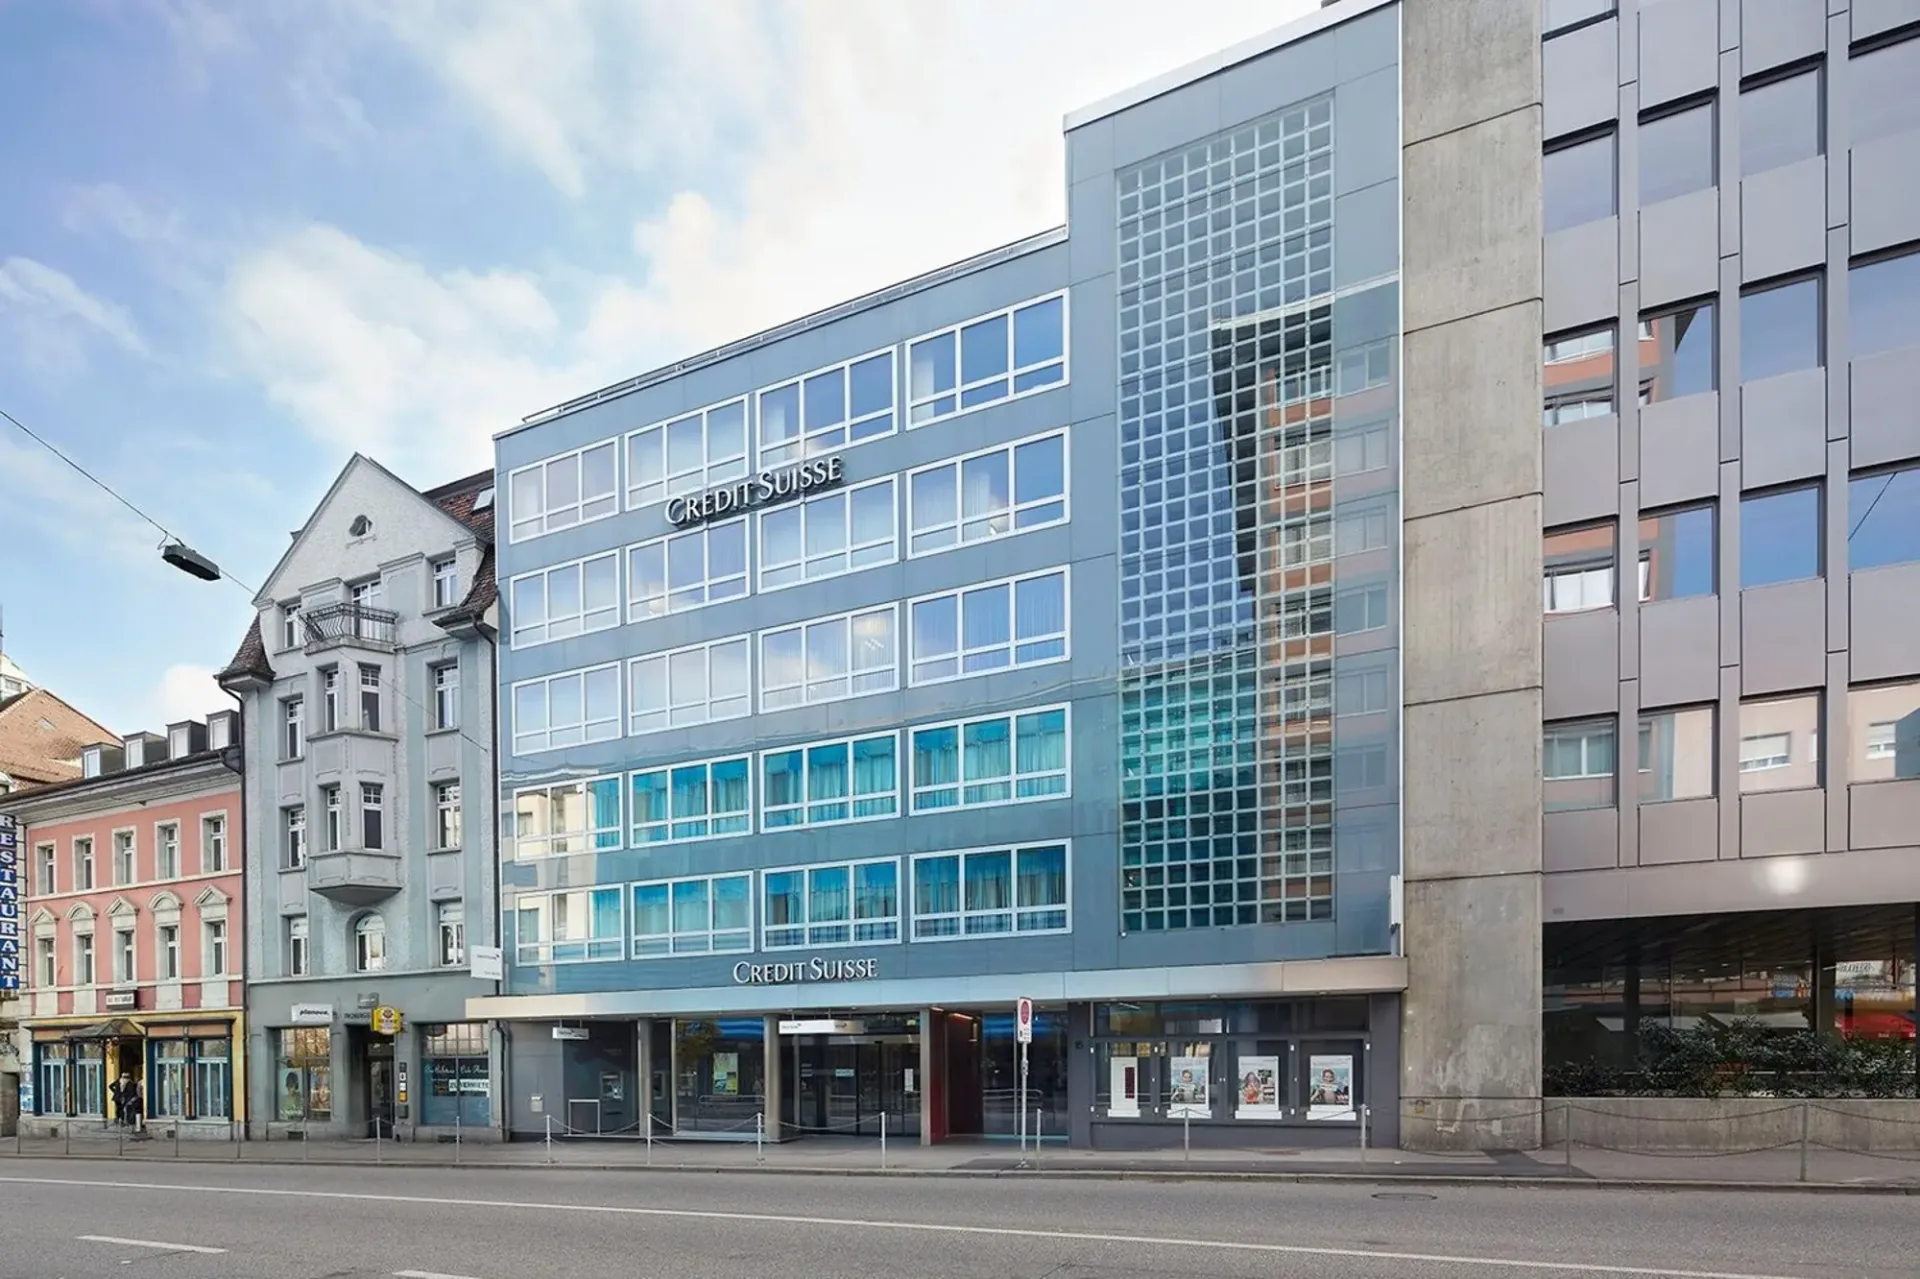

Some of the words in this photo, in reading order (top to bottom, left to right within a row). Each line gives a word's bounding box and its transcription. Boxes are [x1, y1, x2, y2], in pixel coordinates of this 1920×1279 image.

[665, 480, 754, 525] CREDIT
[758, 455, 843, 500] SUISSE
[0, 814, 18, 988] RESTAURANT
[733, 961, 807, 984] CREDIT
[810, 957, 879, 980] SUISSE
